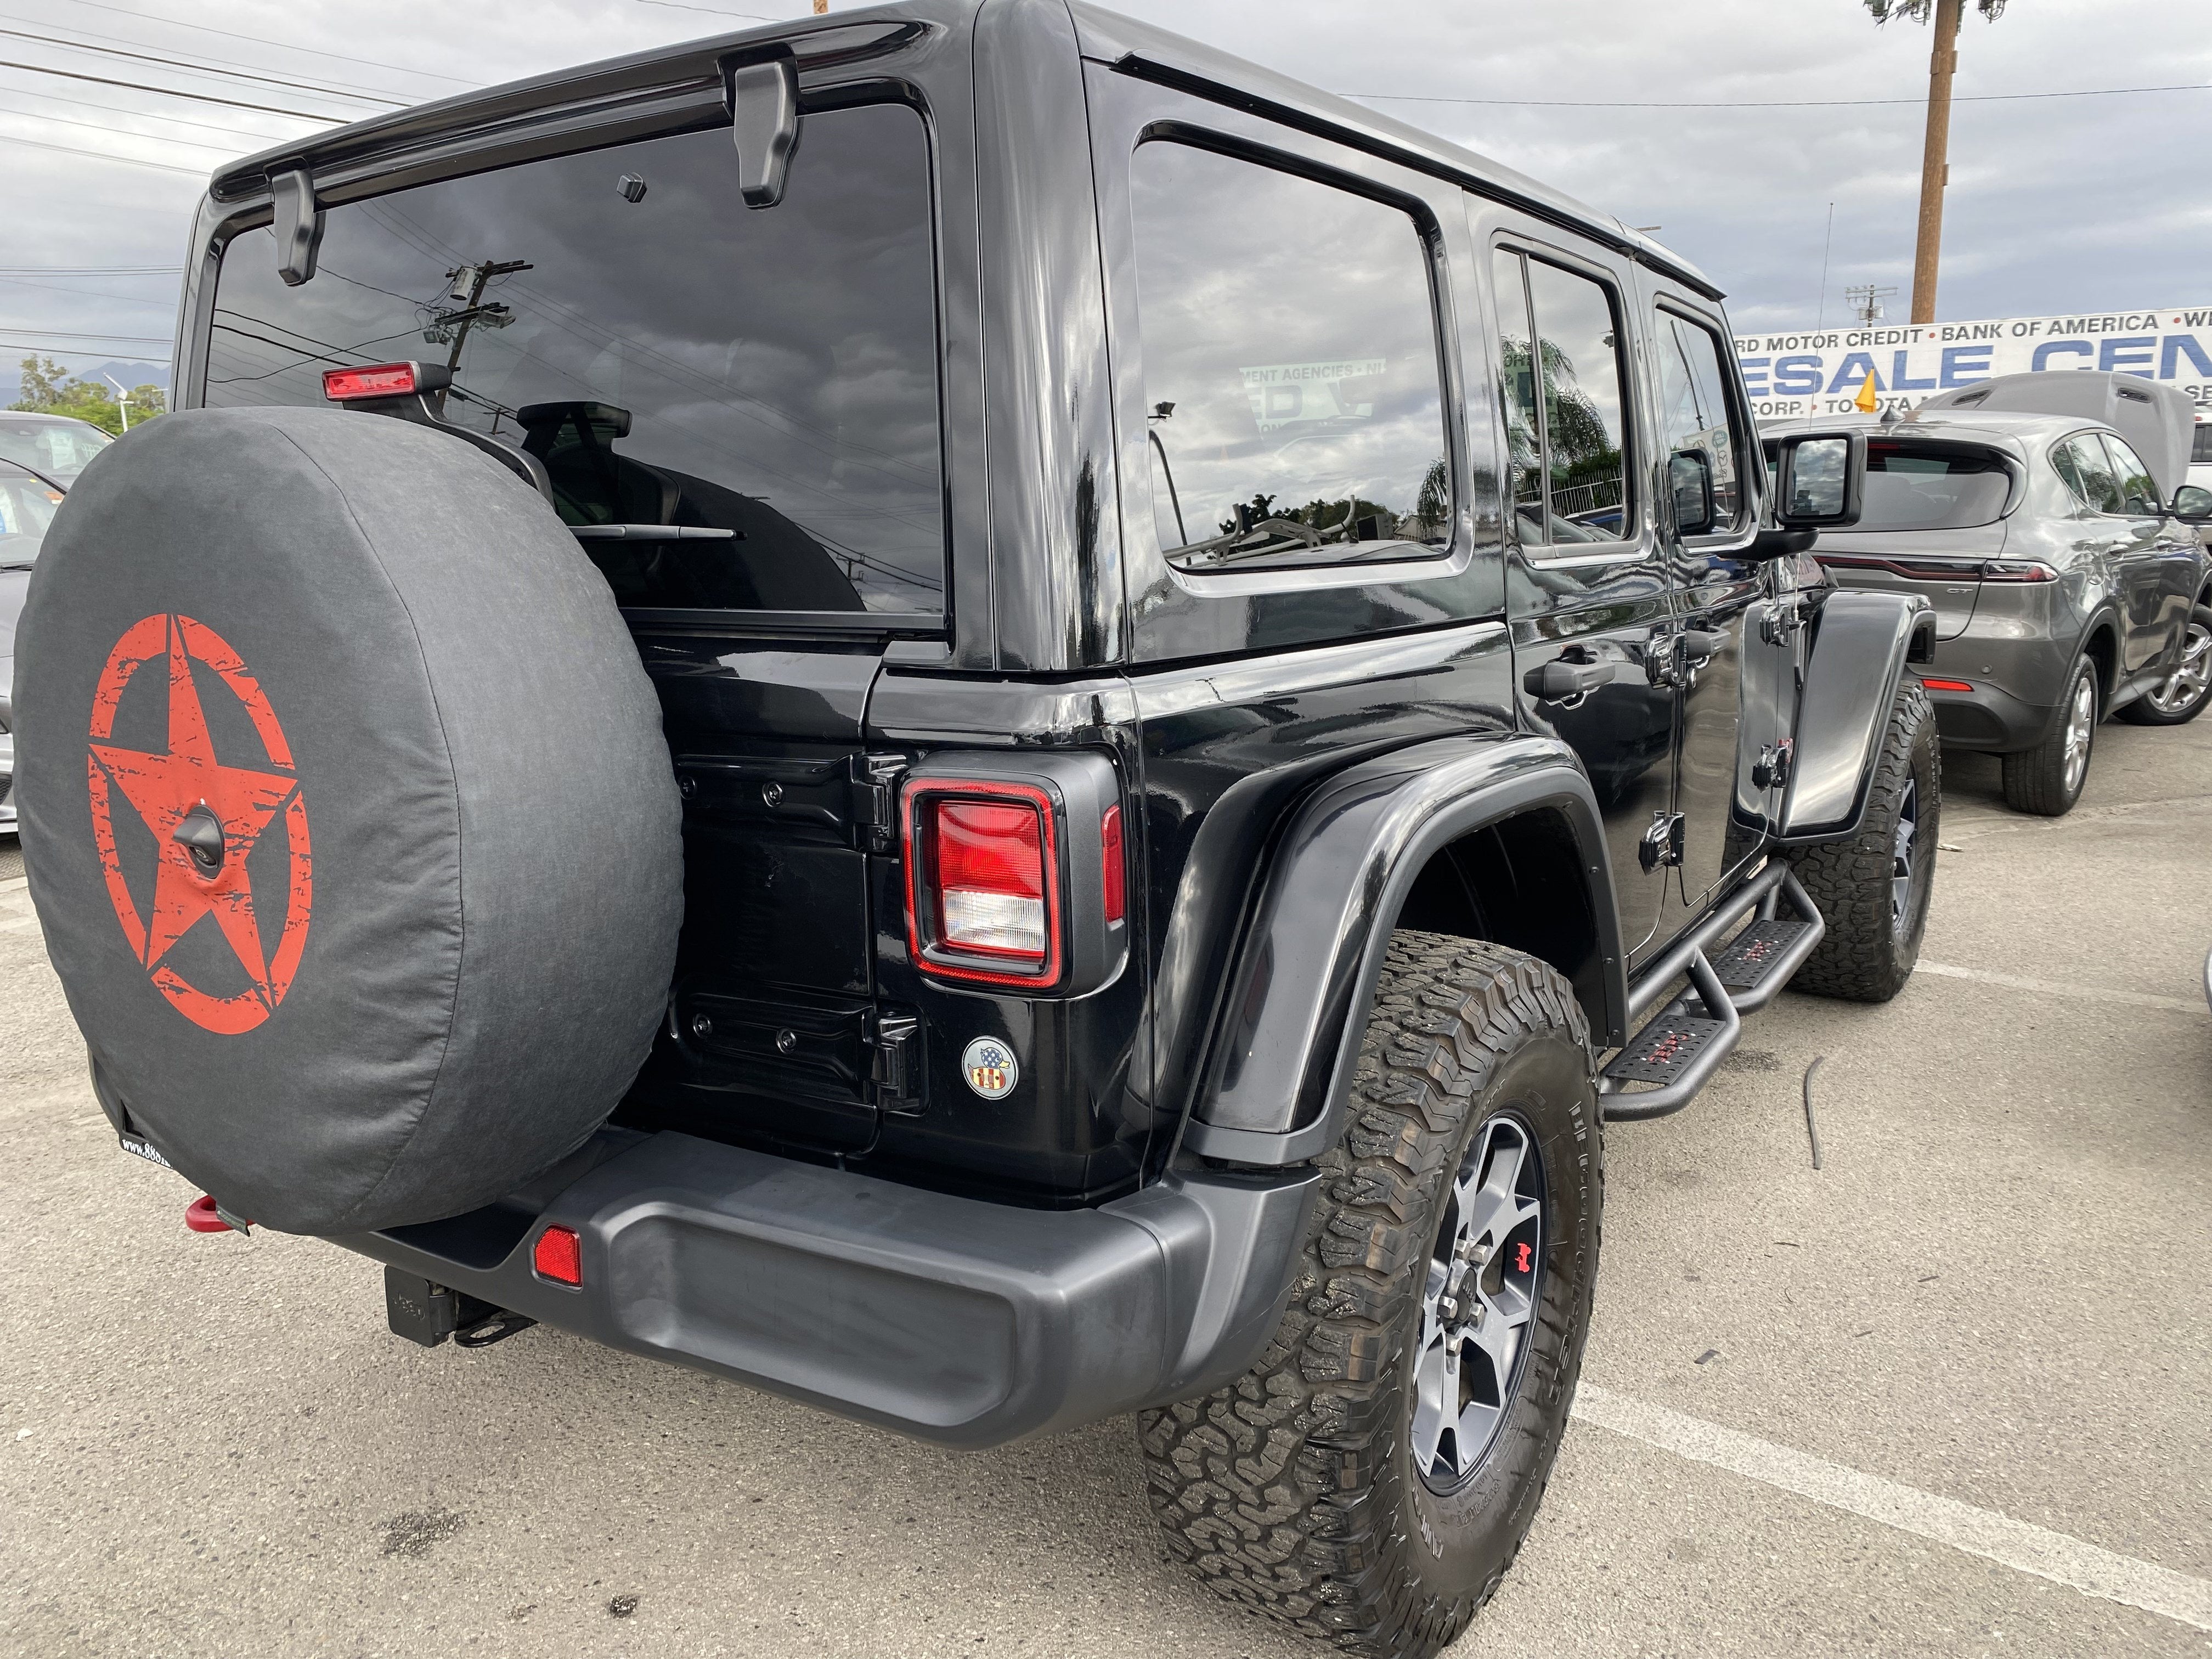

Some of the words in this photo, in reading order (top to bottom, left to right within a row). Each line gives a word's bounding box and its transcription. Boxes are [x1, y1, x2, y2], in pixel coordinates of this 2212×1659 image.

[1767, 334, 1839, 351] MOTOR
[1846, 329, 1923, 347] CREDIT
[1941, 324, 2003, 341] BANK
[2012, 321, 2042, 336] OF
[2047, 315, 2159, 335] AMERICA
[1282, 364, 1353, 380] AGENCIES
[1825, 397, 1912, 413] TOOTA
[392, 1292, 426, 1321] Jeep
